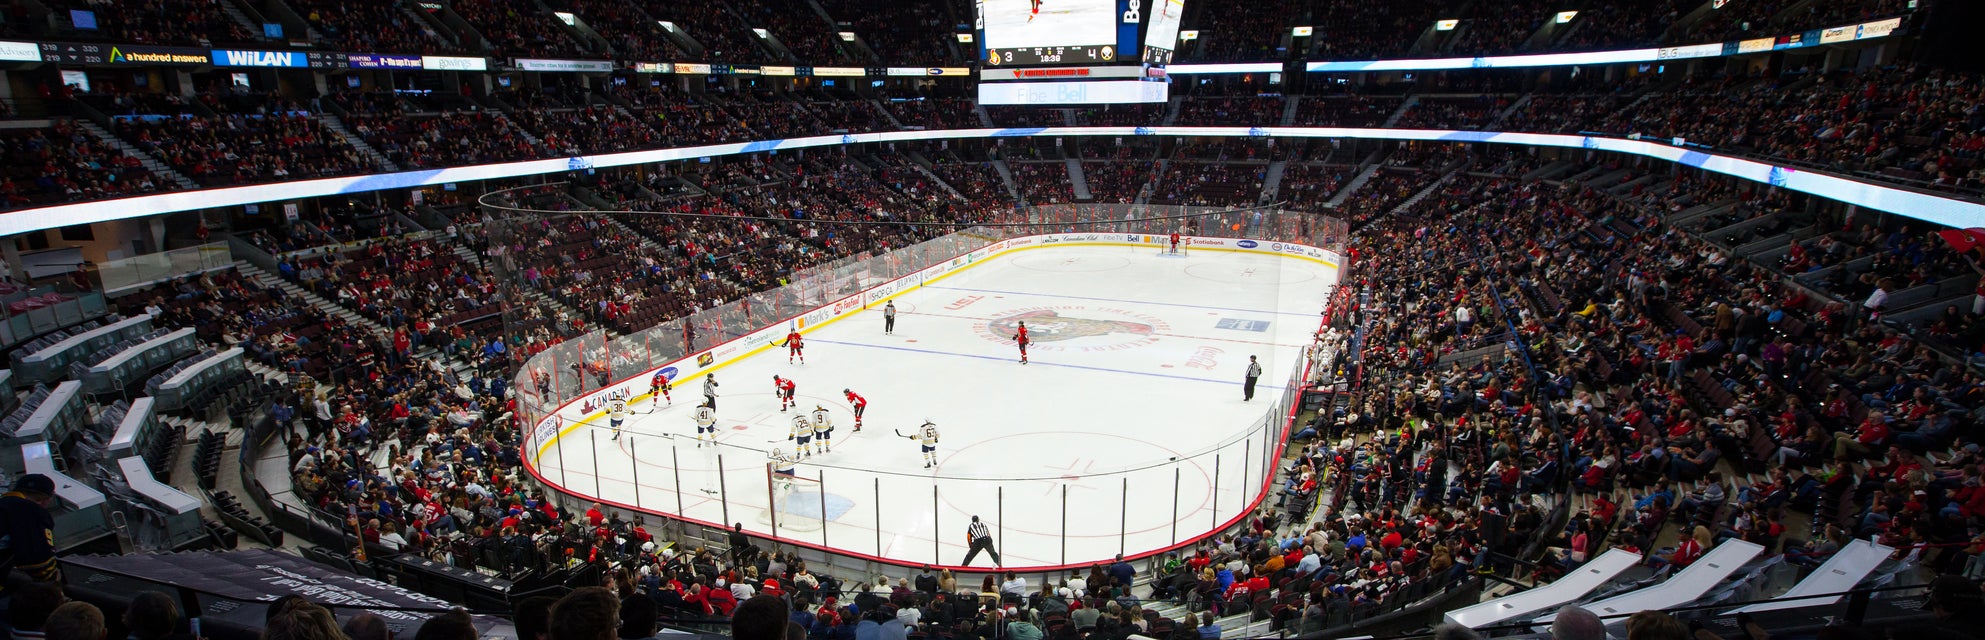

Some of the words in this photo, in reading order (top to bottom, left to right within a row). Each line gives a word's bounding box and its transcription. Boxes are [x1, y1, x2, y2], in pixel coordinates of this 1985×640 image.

[133, 52, 171, 62] hundred
[172, 55, 208, 63] answers
[226, 50, 292, 67] WiLAN
[1004, 51, 1013, 62] 3
[1088, 48, 1097, 60] 4
[1127, 234, 1140, 242] Bell
[1193, 238, 1225, 246] Scotiabank
[804, 310, 830, 326] Mark's
[592, 386, 631, 409] CANADAN
[614, 403, 623, 413] 38
[699, 410, 708, 420] 41
[817, 414, 823, 424] 9
[798, 419, 809, 429] 29
[926, 427, 935, 438] 63
